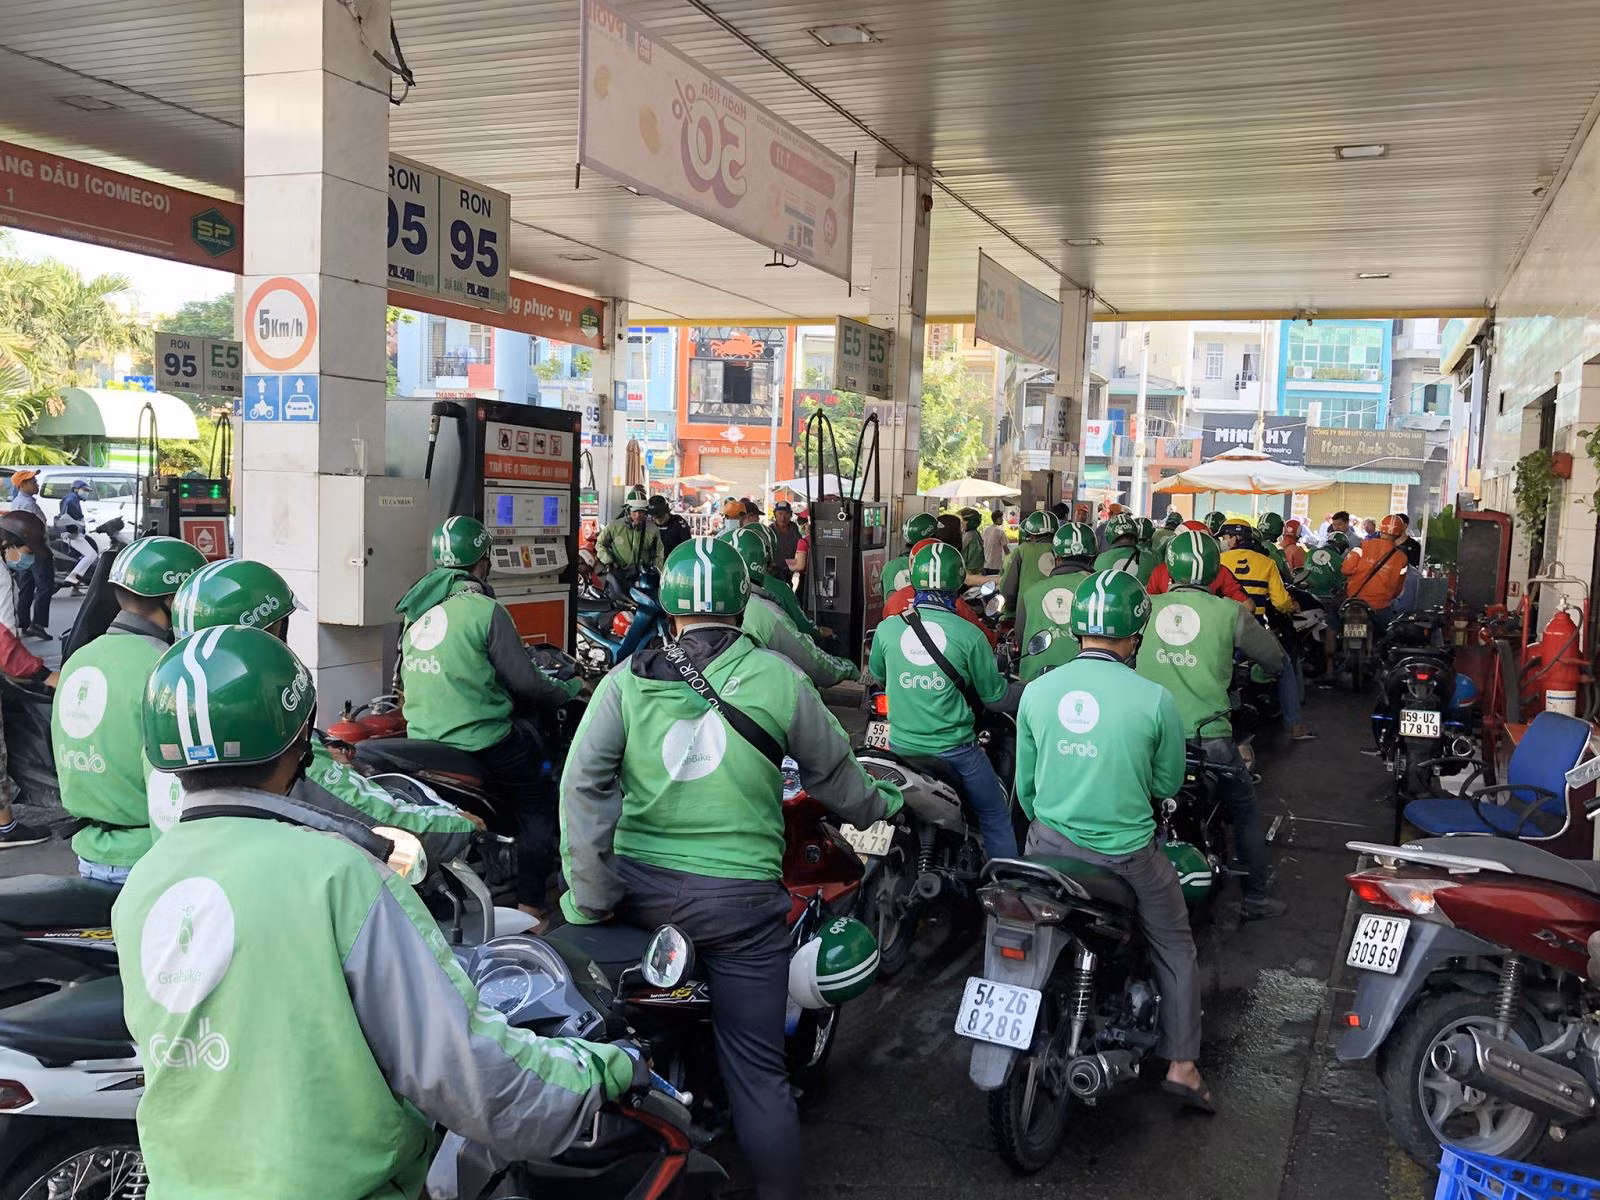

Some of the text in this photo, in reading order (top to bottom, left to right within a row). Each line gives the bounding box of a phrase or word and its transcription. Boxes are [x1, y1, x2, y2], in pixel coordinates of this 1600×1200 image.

[40, 161, 80, 190] DẦU
[85, 173, 171, 213] (COMECO)
[459, 188, 491, 218] RON
[197, 220, 231, 239] SP
[450, 219, 499, 278] 95
[259, 309, 303, 340] 5Km/h
[524, 300, 554, 322] phục
[559, 308, 573, 327] vụ
[170, 339, 190, 350] RON
[843, 325, 861, 356] E5
[869, 333, 885, 363] E5
[164, 352, 197, 377] 95
[211, 344, 240, 368] E5
[212, 370, 228, 379] RON
[586, 405, 600, 422] 95
[1386, 442, 1411, 457] Spa
[239, 594, 280, 628] Grab
[1134, 599, 1149, 618] Gra
[403, 654, 441, 674] Grab
[1156, 648, 1198, 667] Grab
[679, 662, 709, 696] YOUR
[899, 671, 946, 691] Grab
[1406, 711, 1435, 724] 59-U2
[59, 744, 106, 774] Grab
[1057, 739, 1098, 758] Grab
[1363, 918, 1399, 944] 49-B1
[1352, 941, 1398, 968] 309.69
[974, 983, 1029, 1015] 54-Z6
[967, 1008, 1023, 1042] 8286
